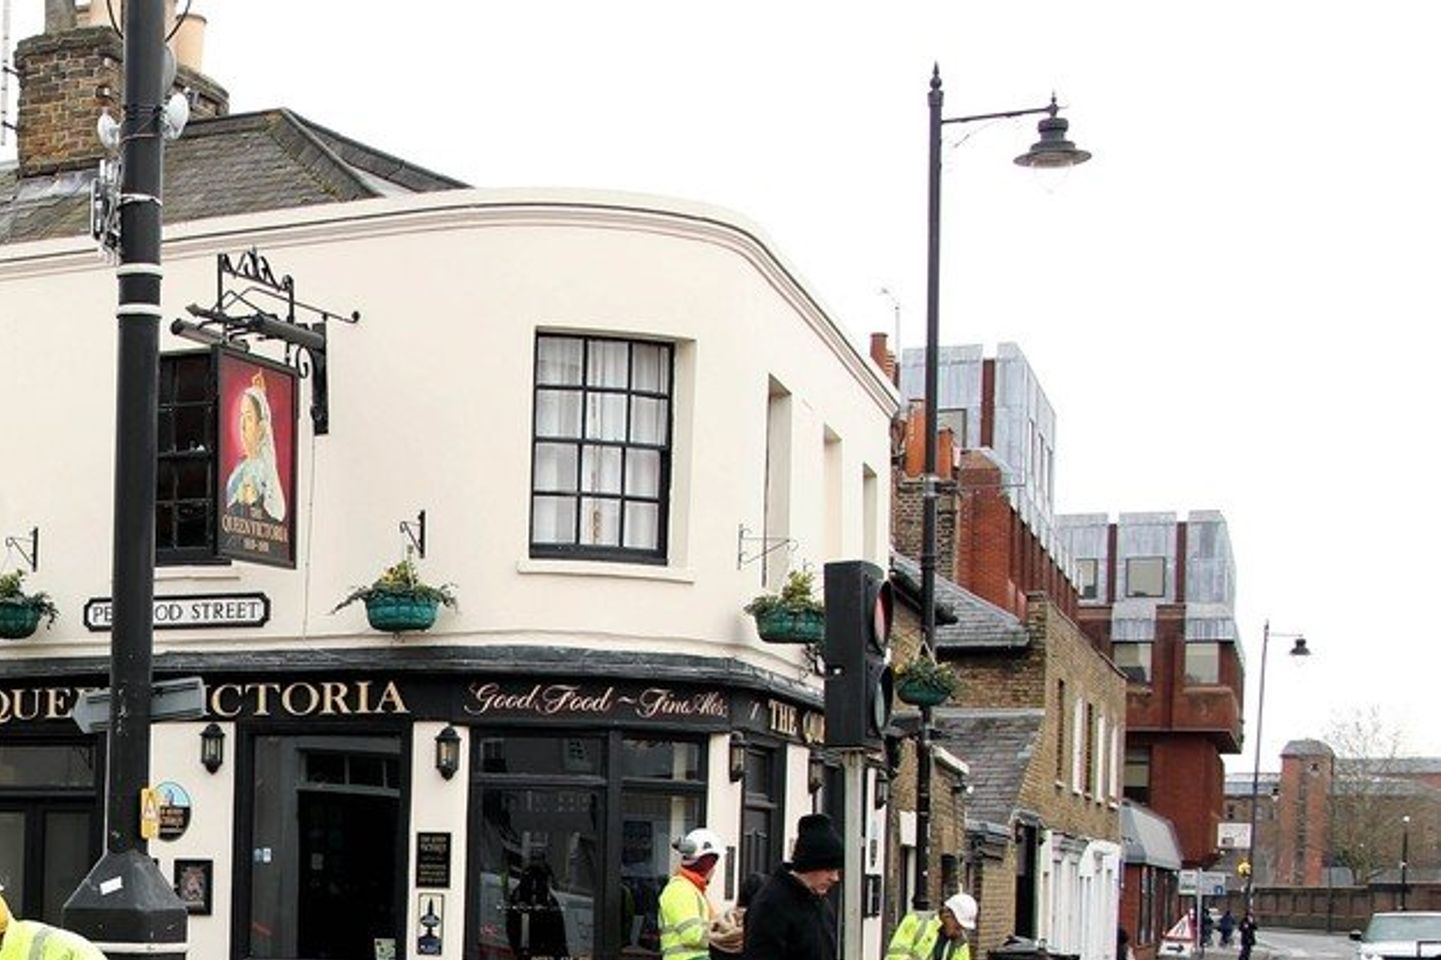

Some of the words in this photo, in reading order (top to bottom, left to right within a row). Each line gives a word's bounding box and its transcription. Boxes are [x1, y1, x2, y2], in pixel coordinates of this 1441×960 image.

[92, 604, 183, 623] PEOD
[191, 601, 259, 620] STREET
[464, 683, 541, 715] Good
[536, 684, 613, 716] Food
[768, 698, 798, 736] THE
